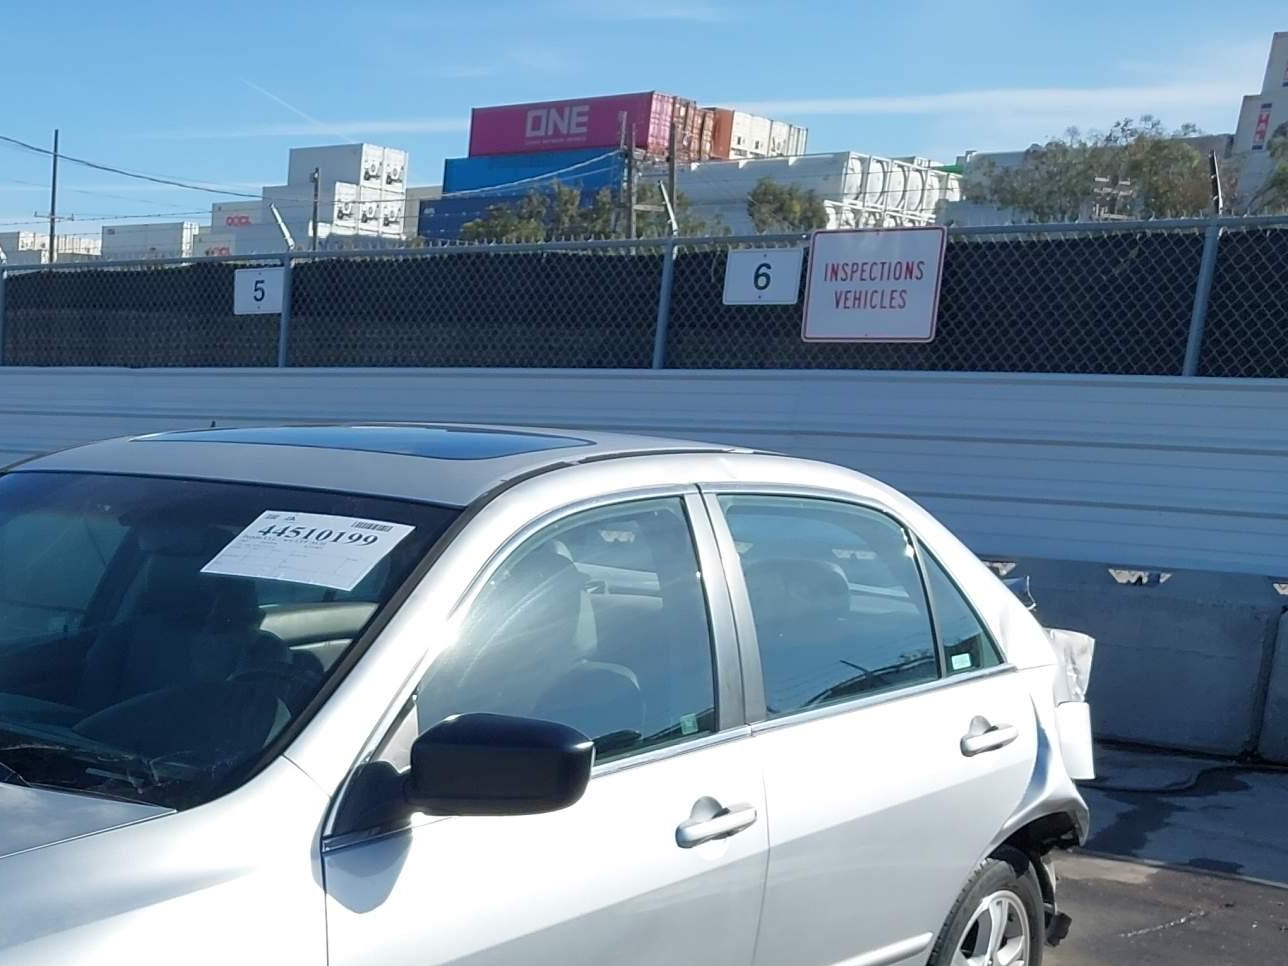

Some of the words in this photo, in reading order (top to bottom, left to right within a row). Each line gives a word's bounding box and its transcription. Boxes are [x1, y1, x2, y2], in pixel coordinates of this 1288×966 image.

[526, 105, 590, 137] ONE
[753, 263, 772, 290] 6
[824, 261, 925, 282] INSPECTIONS
[253, 279, 265, 302] 5
[834, 290, 907, 309] VEHICLES
[258, 524, 379, 547] 44510199
